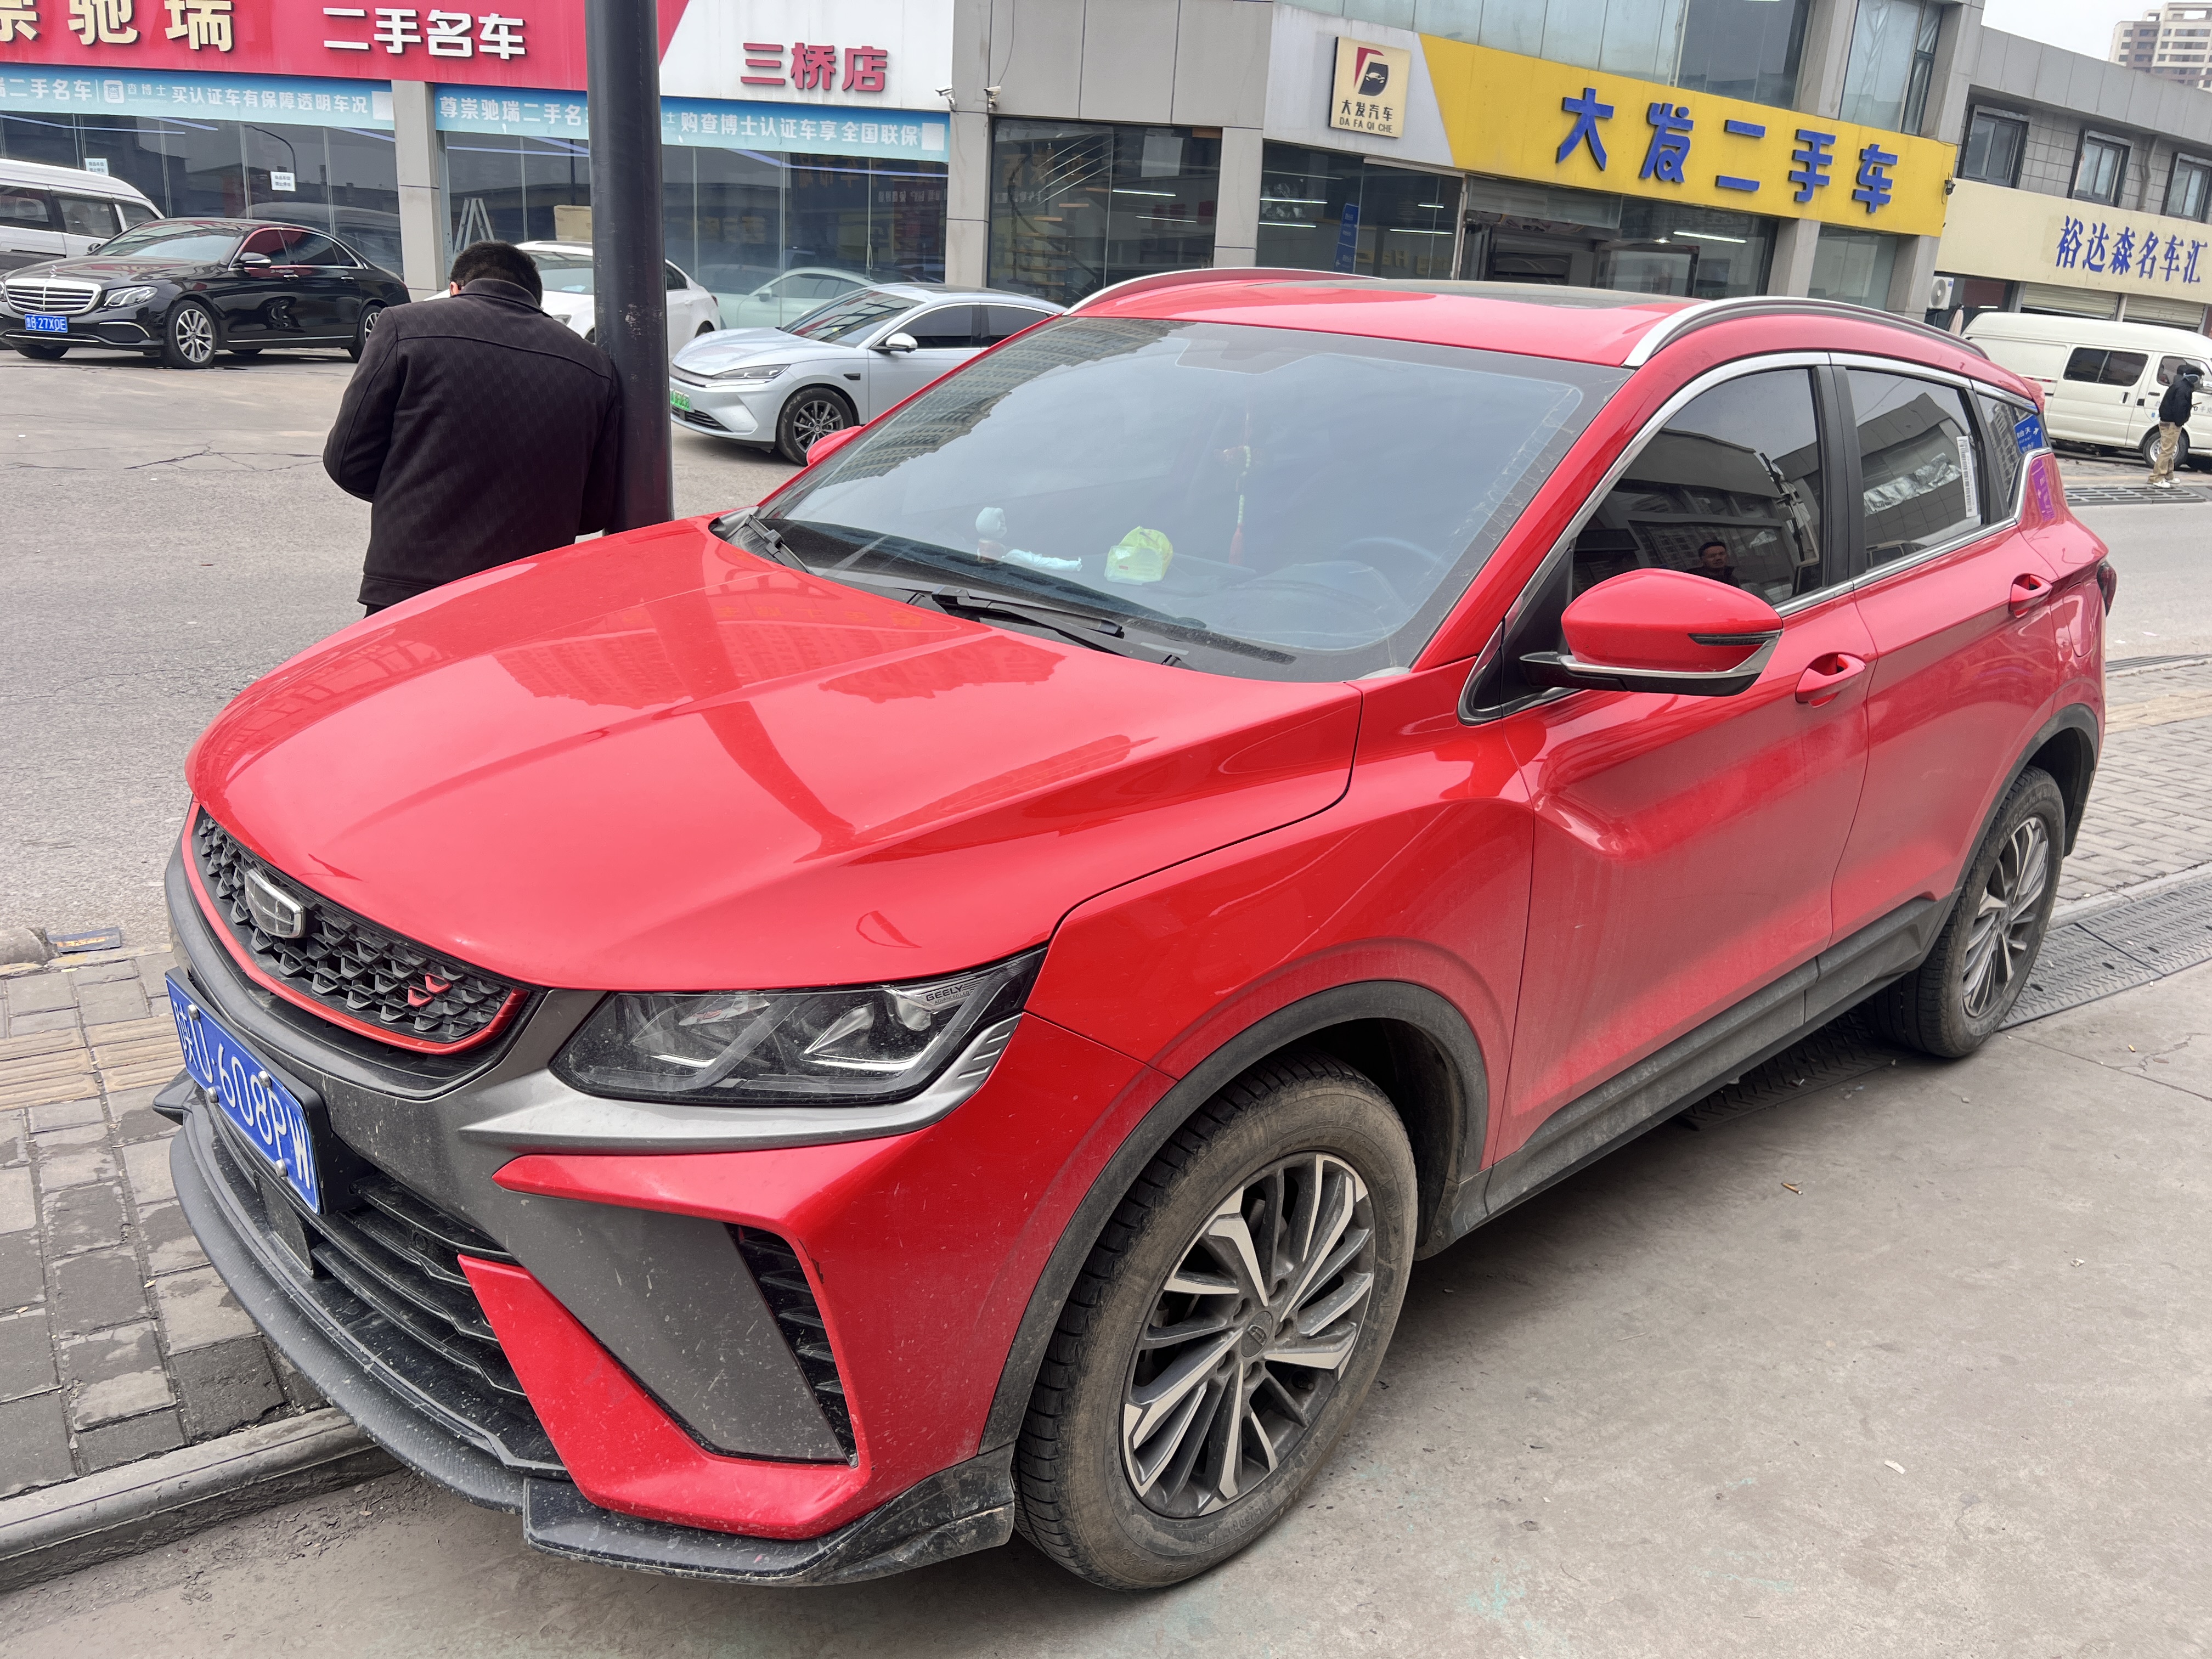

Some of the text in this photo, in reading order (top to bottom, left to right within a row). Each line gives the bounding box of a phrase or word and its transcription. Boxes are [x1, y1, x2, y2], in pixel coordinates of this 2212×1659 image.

[323, 7, 526, 60] 二手名车
[741, 42, 888, 92] 三桥店
[172, 86, 368, 114] 买认证车有保障透明车况
[439, 96, 588, 126] 尊崇驰瑞二手名
[1341, 99, 1393, 121] 大发汽车
[1339, 117, 1393, 133] DA FA QI CHE
[1556, 88, 1898, 213] 大发二手车
[2056, 215, 2208, 284] 裕达森名车汇
[926, 985, 963, 1001] GEELY
[934, 994, 959, 1004] ADVANCED
[172, 1000, 311, 1190] 陕U·608PW
